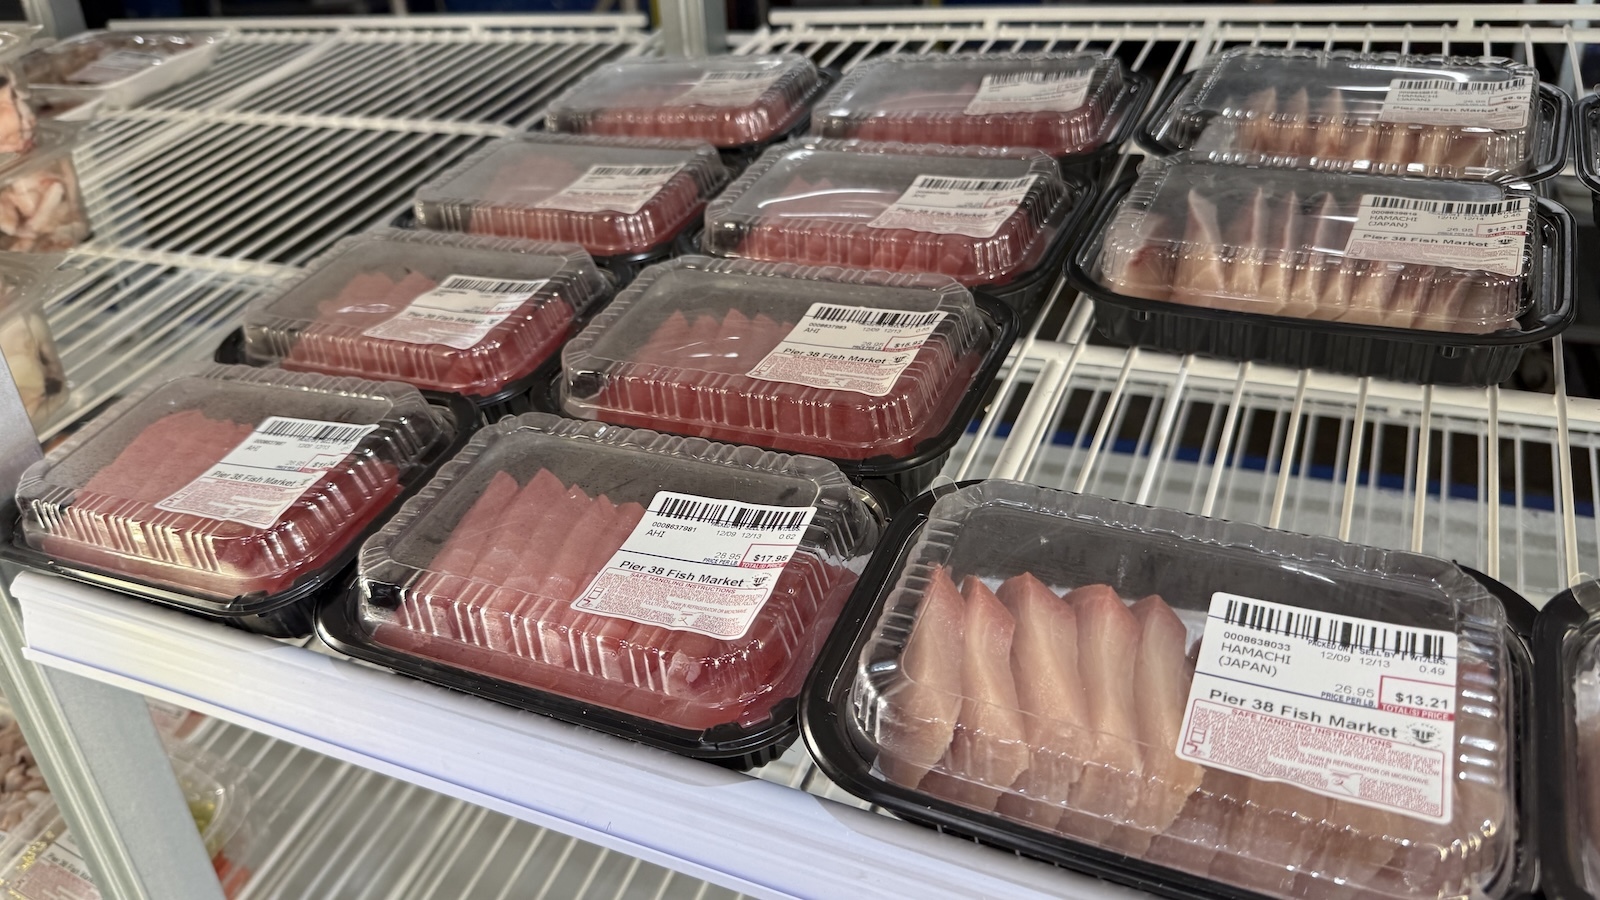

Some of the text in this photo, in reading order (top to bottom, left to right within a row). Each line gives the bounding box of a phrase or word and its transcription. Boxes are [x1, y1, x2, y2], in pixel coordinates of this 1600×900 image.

[1368, 221, 1409, 229] (JAPAN)
[1487, 224, 1524, 234] $12.13
[1443, 239, 1489, 247] Market
[783, 347, 805, 356] Pier
[822, 352, 846, 361] Fish
[848, 355, 887, 364] Market
[211, 470, 231, 478] Pier
[243, 474, 264, 483] Fish
[264, 477, 297, 487] Market
[645, 529, 666, 538] AHI
[716, 529, 738, 538] 12/09
[741, 531, 763, 540] 12/13
[753, 554, 789, 563] $17.95
[619, 560, 745, 588] Pier 38 Fish Market
[630, 572, 737, 595] SAFE HANDLING INSTRUCTIONS
[1223, 631, 1291, 652] 0008638033
[1308, 639, 1339, 652] PACKED
[1360, 647, 1381, 658] SELL
[1221, 642, 1291, 665] HAMACHI
[1218, 655, 1278, 678] (JAPAN)
[1320, 651, 1446, 676] 12/09 12/13 0.49
[1321, 691, 1377, 708] PRICE PER LB.
[1335, 683, 1375, 699] 26.95
[1395, 692, 1449, 710] $13.21
[1208, 688, 1247, 707] Pier
[1252, 699, 1274, 714] 38
[1280, 705, 1322, 725] Fish
[1329, 715, 1398, 740] Market
[1421, 710, 1449, 720] PRICE
[1232, 708, 1257, 720] SAFE
[1260, 715, 1312, 733] HANDLING
[1315, 725, 1392, 749] INSTRUCTIONS
